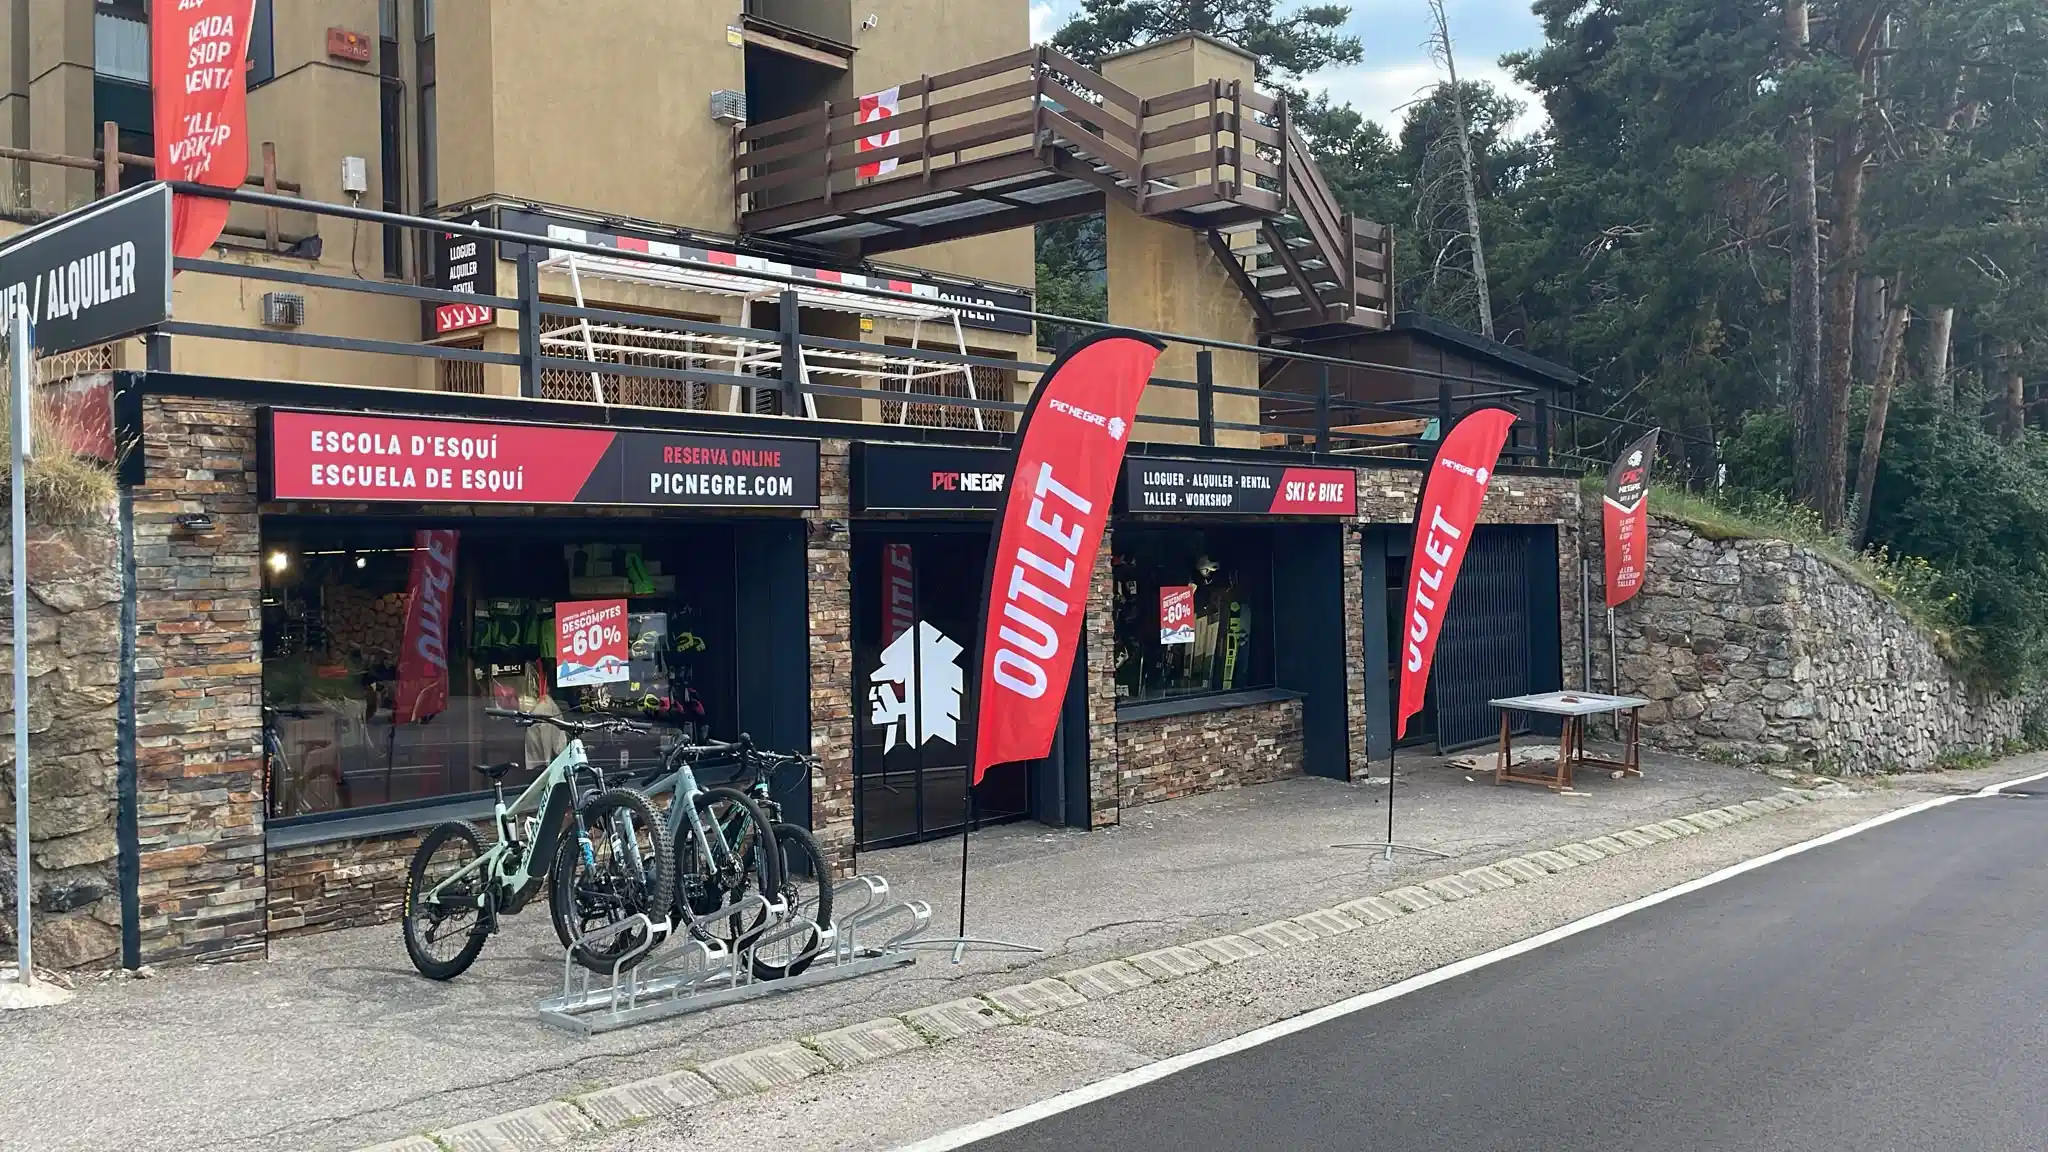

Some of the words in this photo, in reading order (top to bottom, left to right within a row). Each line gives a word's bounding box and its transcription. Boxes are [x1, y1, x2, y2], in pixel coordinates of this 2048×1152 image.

[187, 41, 232, 69] SHOP
[449, 242, 477, 261] LLOGUER
[47, 240, 137, 321] ALQUILER
[449, 261, 478, 280] ALQUILER
[311, 430, 402, 455] ESCOLA
[411, 433, 498, 461] D'ESQUÍ
[663, 446, 728, 466] RESERVA
[731, 449, 781, 468] ONLINE
[311, 463, 417, 488] ESCUELA
[425, 467, 453, 489] DE
[461, 465, 524, 493] ESQUÍ
[650, 472, 793, 496] PICNEGRE.COM
[931, 471, 959, 491] PIC
[960, 472, 1006, 492] NEGR
[1143, 471, 1184, 487] LLOGUER
[1192, 473, 1234, 489] ALQUILER
[1241, 475, 1271, 490] RENTAL
[1143, 491, 1177, 506] TALLER
[1185, 492, 1233, 507] WORKSHOP
[1285, 481, 1305, 503] SKI
[1307, 482, 1316, 502] &
[1318, 482, 1345, 503] BIKE
[993, 461, 1093, 700] OUTLET
[562, 605, 622, 635] DESCOMPTES
[1162, 602, 1191, 624] -60%
[562, 624, 622, 656] -60%
[497, 664, 521, 672] LEKI
